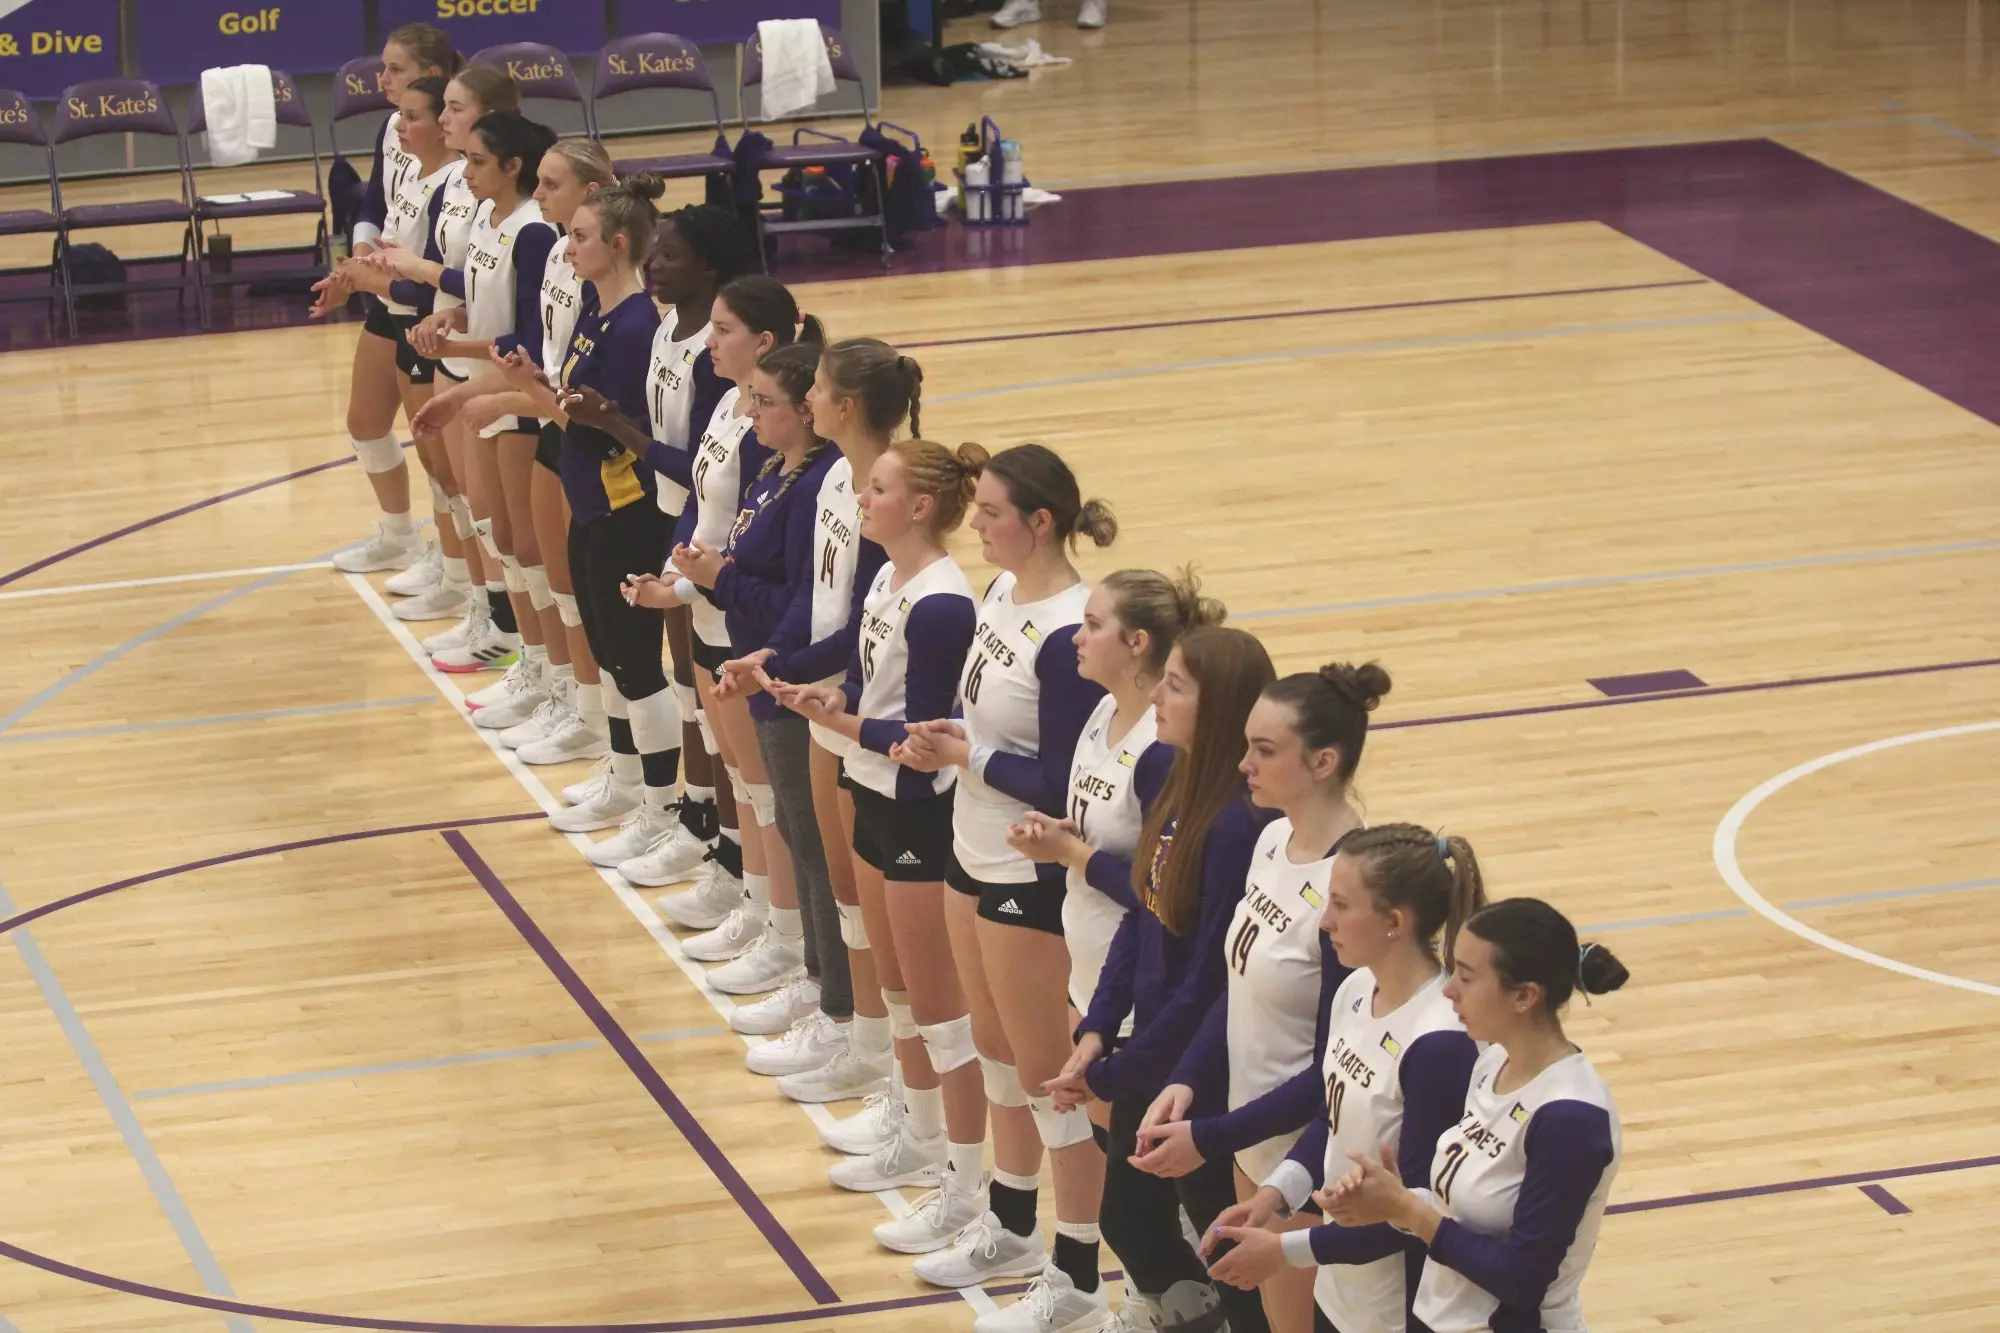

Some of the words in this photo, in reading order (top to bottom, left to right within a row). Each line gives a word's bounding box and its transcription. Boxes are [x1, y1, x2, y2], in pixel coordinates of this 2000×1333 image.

[218, 8, 281, 35] Golf
[436, 0, 538, 18] Soccer
[0, 33, 20, 56] &
[31, 30, 103, 55] Dive
[506, 56, 564, 81] Kate's
[607, 53, 634, 76] St.
[638, 49, 696, 74] Kate's
[345, 73, 372, 95] St.
[67, 97, 95, 119] St.
[98, 90, 158, 117] Kate's
[440, 219, 447, 255] 6
[470, 266, 478, 303] 7
[545, 304, 554, 340] 9
[655, 384, 664, 428] 11
[695, 456, 709, 502] 12
[821, 508, 834, 529] ST.
[820, 537, 838, 590] 14
[863, 637, 877, 683] 15
[983, 630, 1016, 668] KATE'S
[964, 650, 988, 706] 16
[1071, 794, 1090, 844] 17
[997, 905, 1023, 915] adidas
[1252, 892, 1292, 933] KATE'S
[1231, 915, 1260, 977] 19
[1338, 1048, 1376, 1088] KATE'S
[1326, 1071, 1346, 1136] 20
[1435, 1142, 1469, 1206] 21
